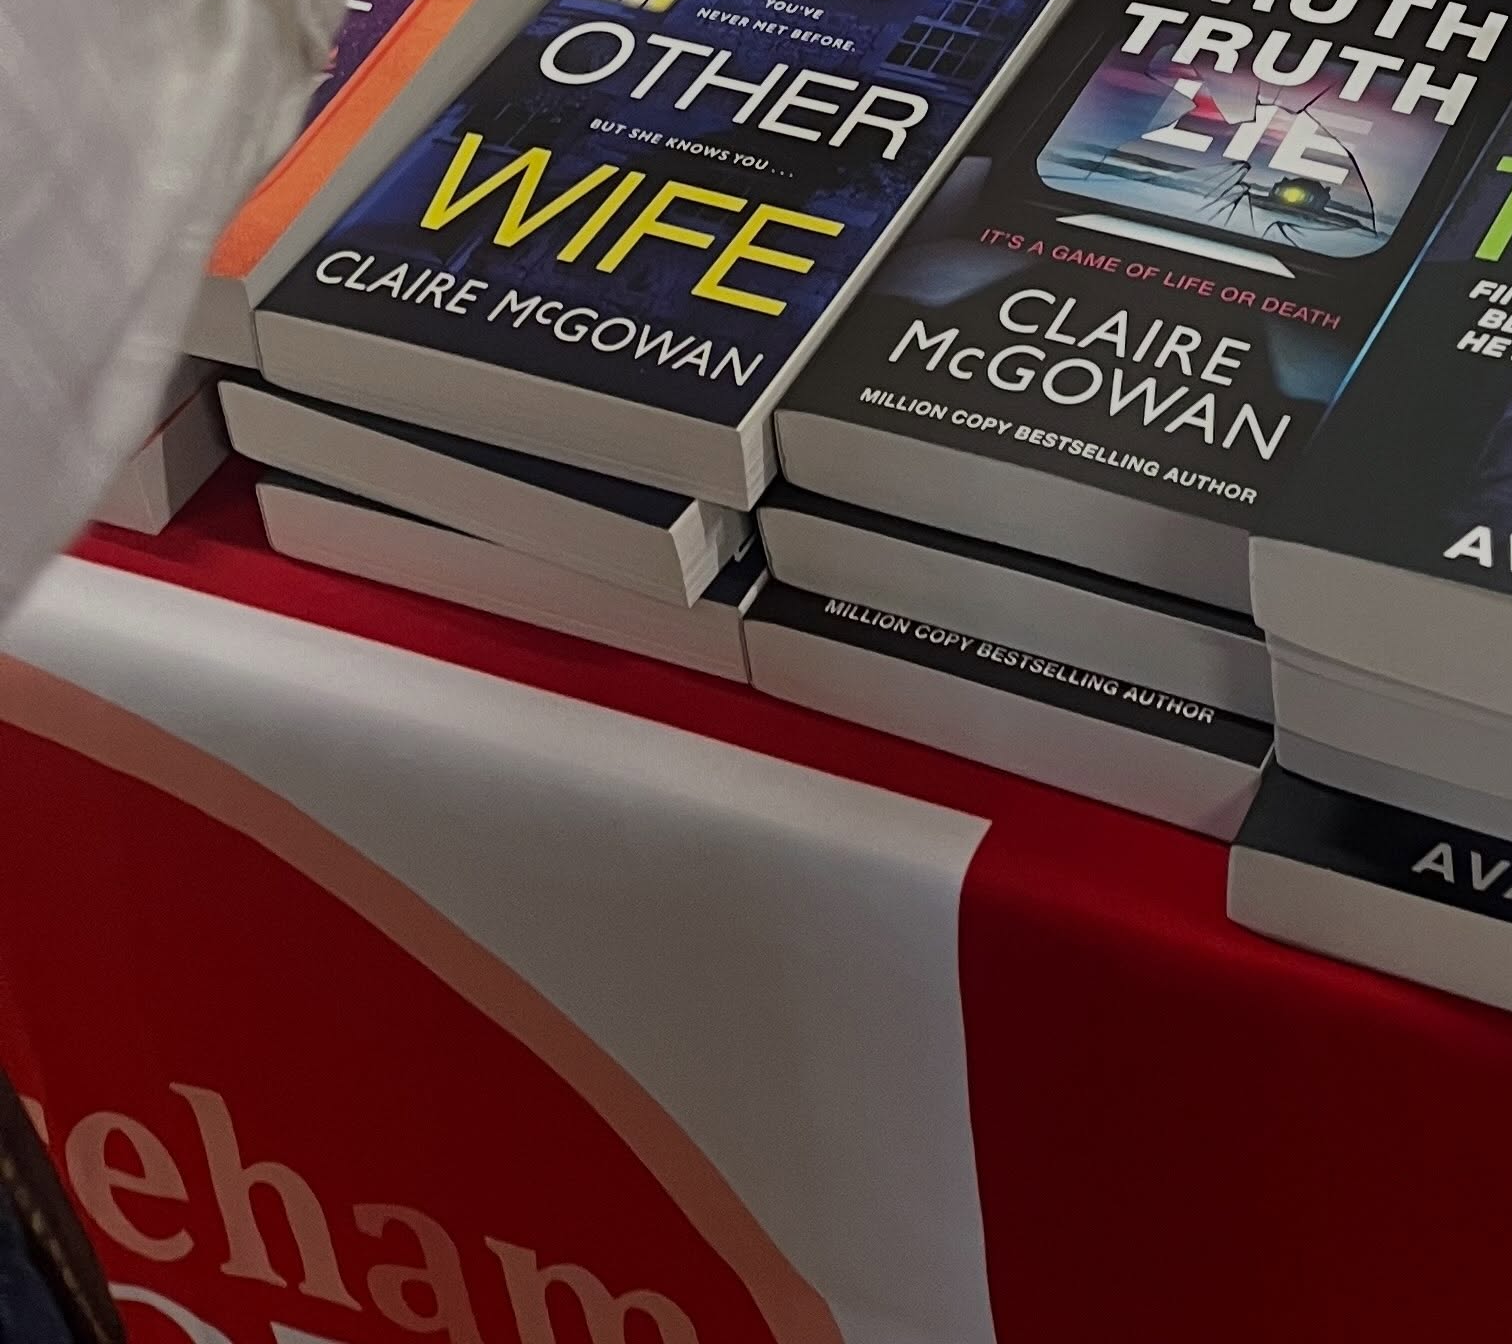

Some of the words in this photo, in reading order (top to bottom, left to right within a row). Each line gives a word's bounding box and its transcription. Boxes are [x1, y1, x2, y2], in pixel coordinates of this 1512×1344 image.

[697, 7, 750, 27] NEVER
[752, 20, 788, 35] MET
[790, 28, 856, 52] BEFORE.
[1117, 2, 1479, 127] TRUTH
[538, 20, 931, 163] OTHER
[590, 118, 627, 134] BUT
[628, 128, 664, 145] SHE
[665, 137, 731, 161] KNOWS
[1140, 79, 1374, 186] LIE
[419, 132, 846, 317] WIFE
[980, 228, 1025, 251] IT'S
[1028, 240, 1045, 255] A
[1052, 244, 1122, 273] GAME
[1125, 263, 1160, 281] OF
[1163, 271, 1215, 297] LIFE
[1220, 286, 1257, 307] OR
[1261, 296, 1342, 330] DEATH
[314, 250, 490, 317] CLAIRE
[488, 288, 765, 388] McGOWAN
[998, 286, 1254, 389] CLAIRE
[1457, 330, 1512, 358] HE
[859, 386, 948, 421] MILLION
[949, 406, 1013, 437] COPY
[1014, 422, 1161, 478] BESTSELLING
[1162, 464, 1259, 505] AUTHOR
[887, 318, 1292, 462] McGOWAN
